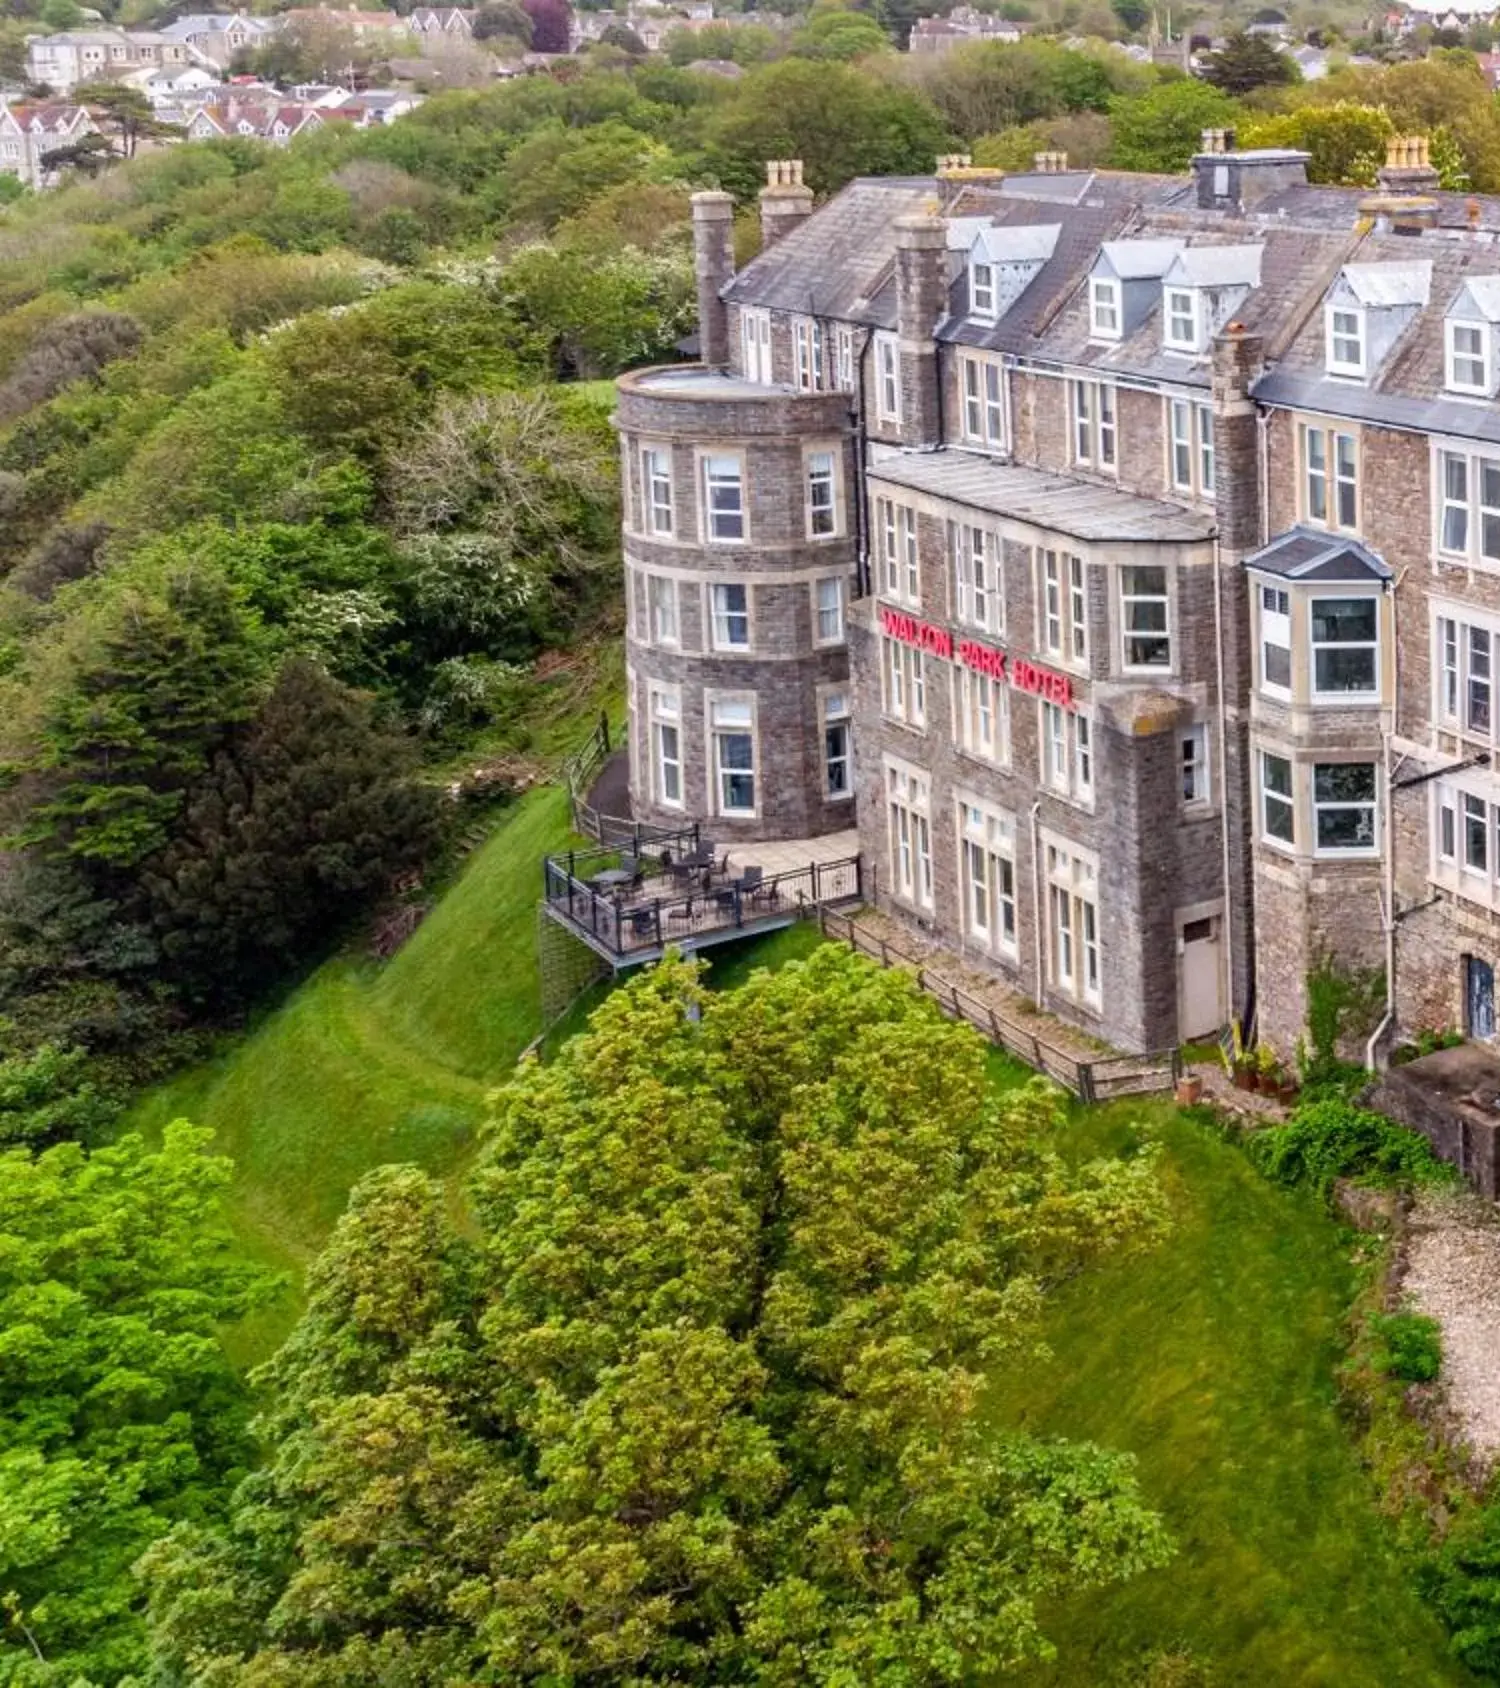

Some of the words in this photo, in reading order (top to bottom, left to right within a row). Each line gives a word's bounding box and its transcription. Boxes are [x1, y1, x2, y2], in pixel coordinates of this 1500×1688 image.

[881, 607, 954, 659] WALTON
[960, 640, 1007, 681] PARK
[1012, 658, 1073, 705] HOTEL
